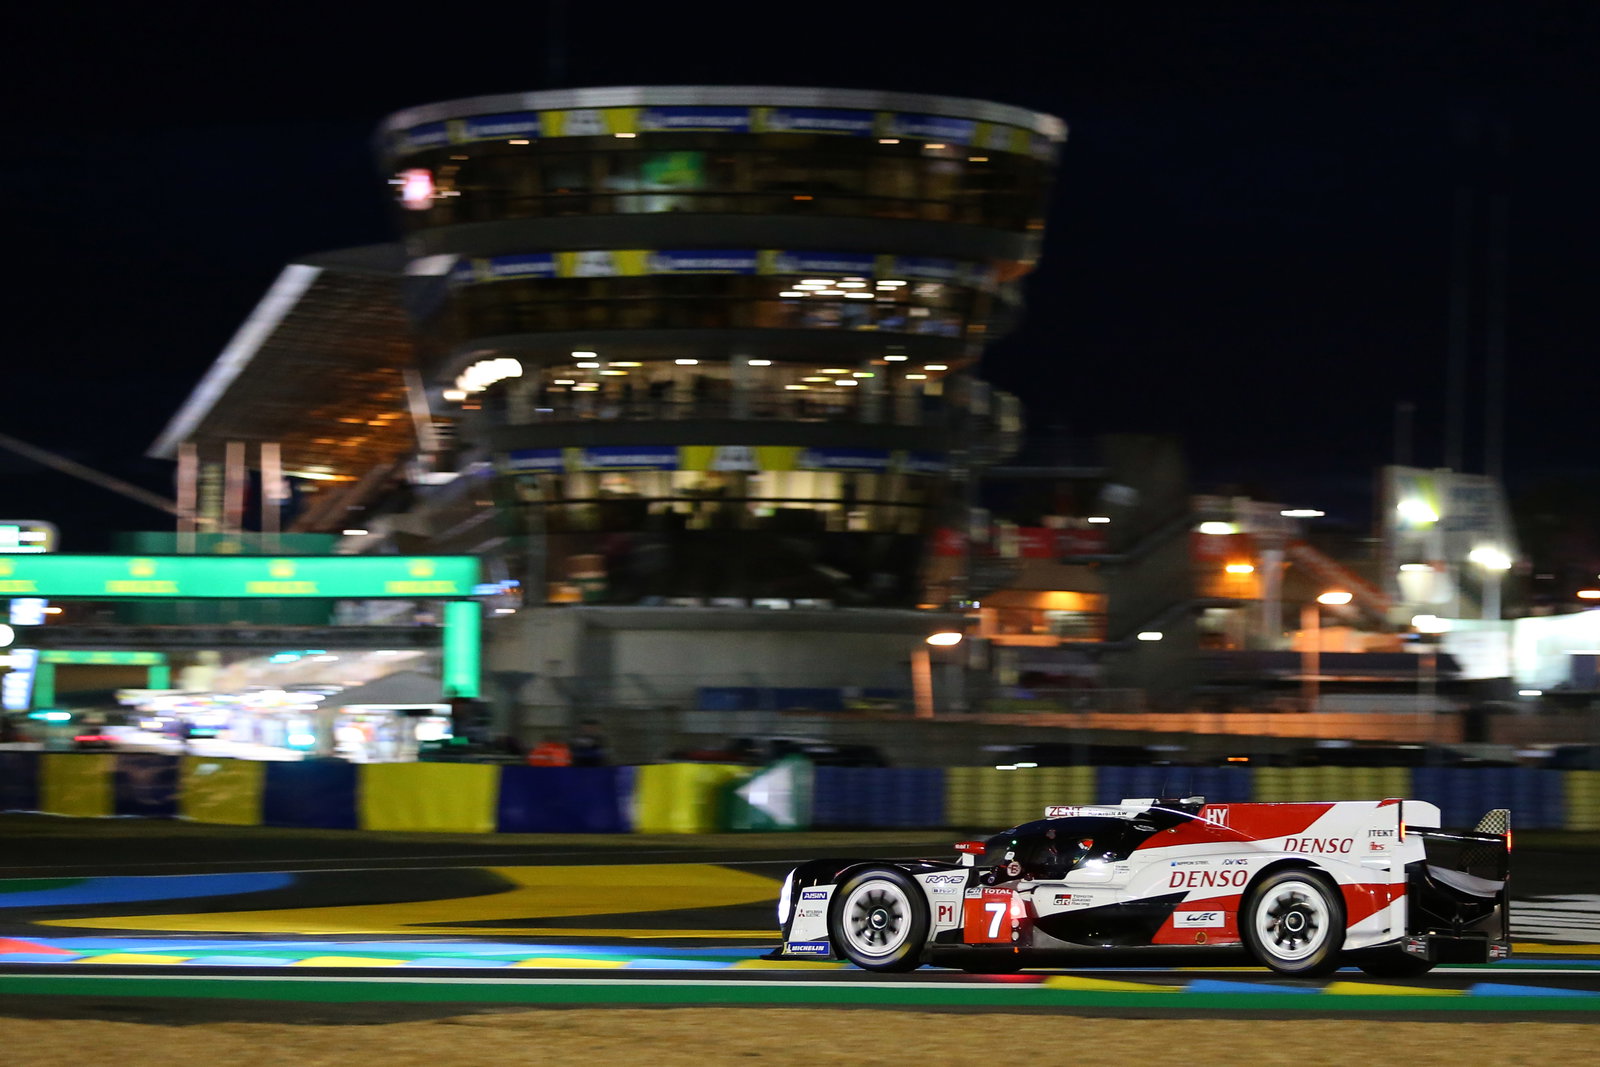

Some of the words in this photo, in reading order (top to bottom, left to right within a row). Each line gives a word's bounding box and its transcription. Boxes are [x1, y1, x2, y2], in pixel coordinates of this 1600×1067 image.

[1206, 809, 1228, 825] HY
[1283, 838, 1354, 853] DENSO
[925, 875, 964, 884] RAYS
[1169, 870, 1248, 888] DENSO
[938, 906, 953, 922] P1
[985, 902, 1006, 938] 7
